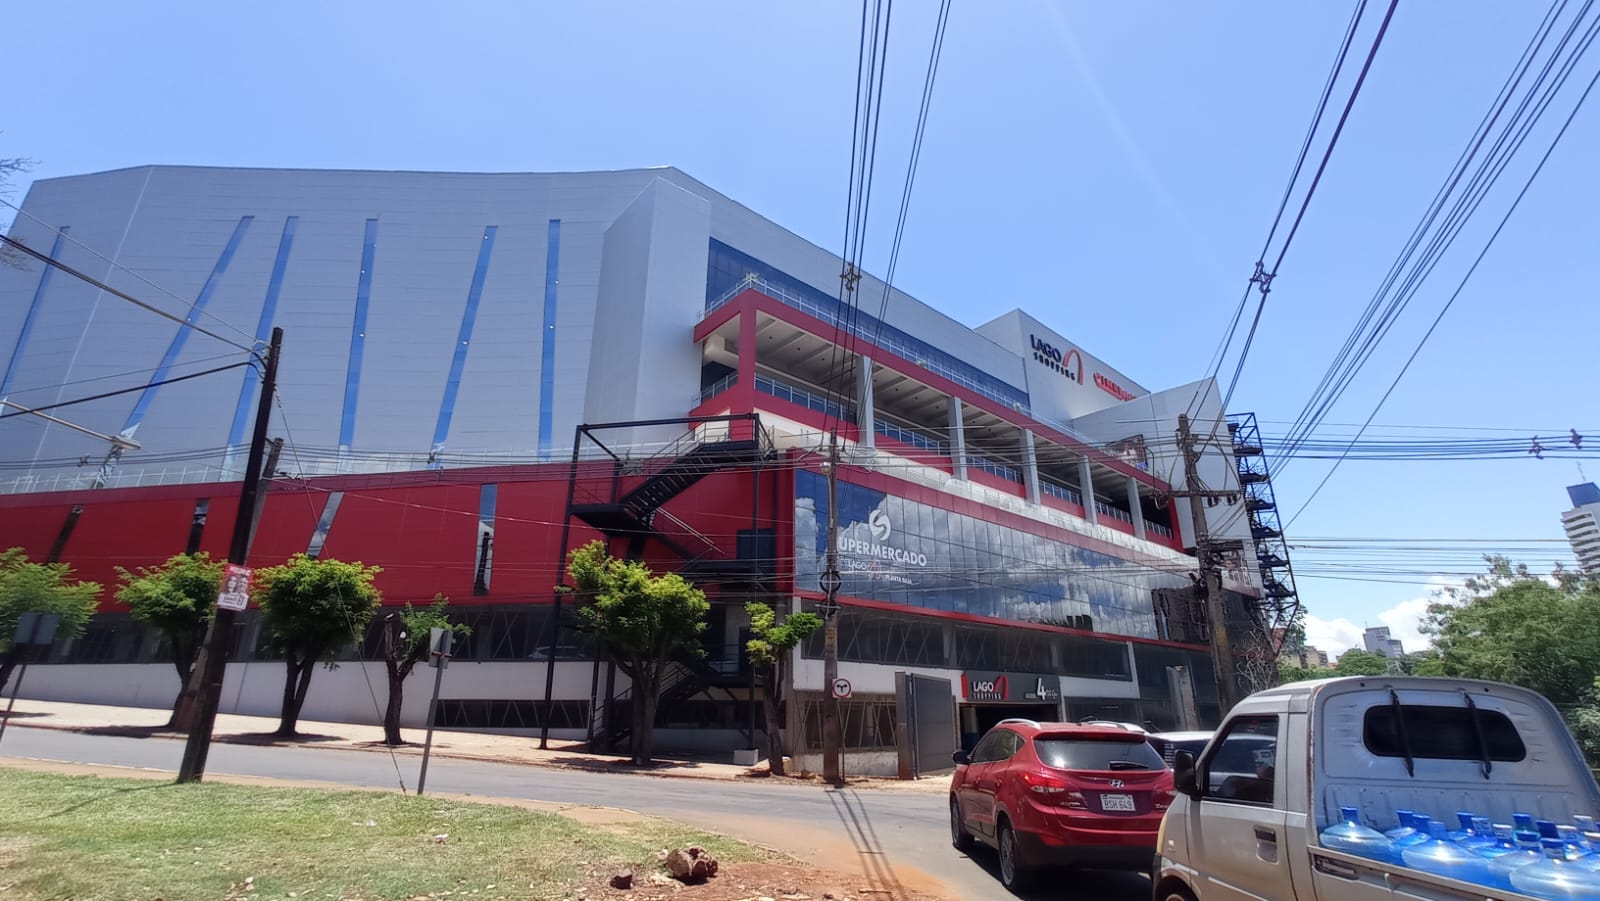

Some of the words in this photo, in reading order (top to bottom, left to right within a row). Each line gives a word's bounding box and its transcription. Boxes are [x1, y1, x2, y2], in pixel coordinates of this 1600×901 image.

[1030, 334, 1062, 363] LAGO
[838, 537, 927, 566] UPERMERCADO
[973, 681, 994, 692] LAGO
[1036, 677, 1047, 701] 4
